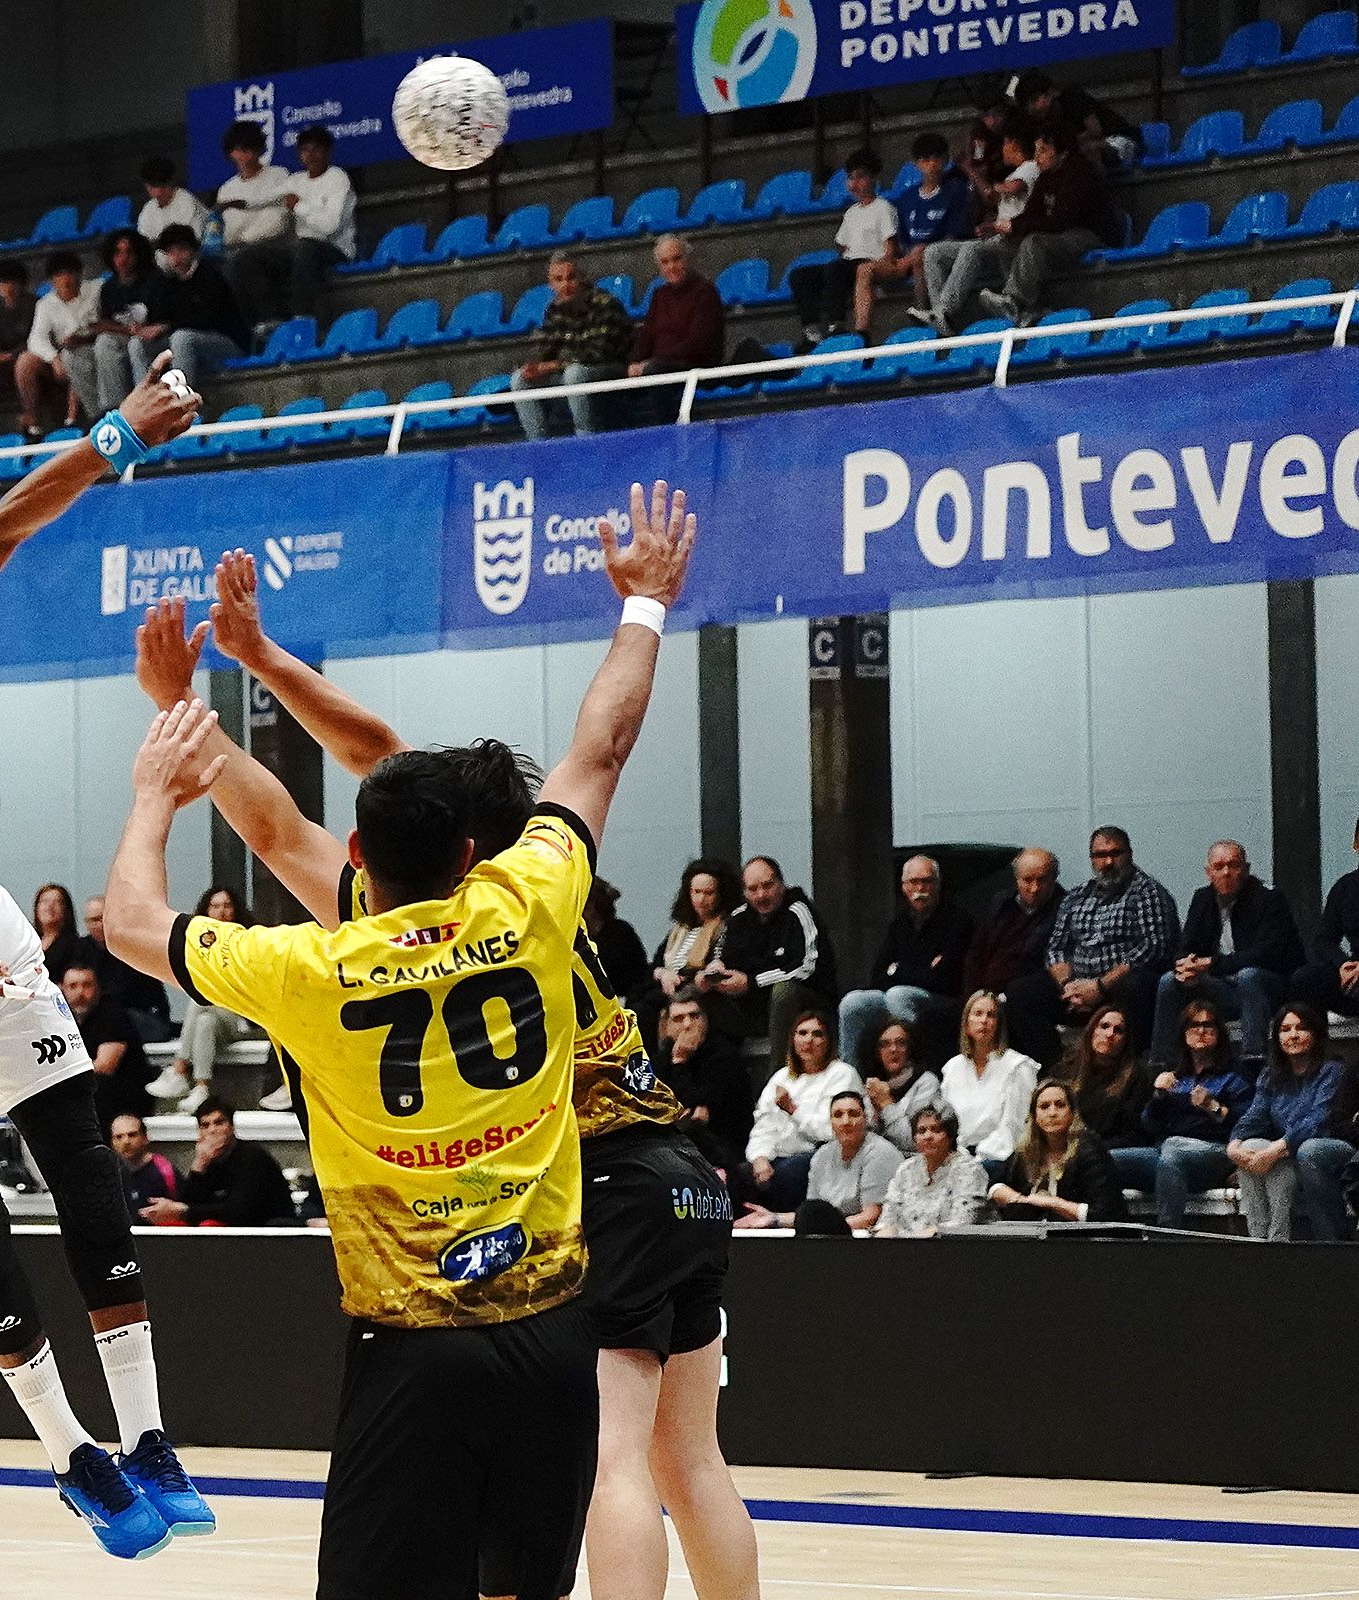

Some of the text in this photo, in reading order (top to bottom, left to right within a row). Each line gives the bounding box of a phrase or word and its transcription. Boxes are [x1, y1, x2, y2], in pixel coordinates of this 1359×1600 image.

[841, 0, 1140, 68] PONTEVEDRA
[131, 546, 204, 576] XUNTA
[543, 547, 572, 575] de
[130, 573, 219, 605] DE GALI
[337, 930, 520, 989] L. GAVILANES
[340, 966, 547, 1118] 70
[411, 1195, 464, 1218] Caja
